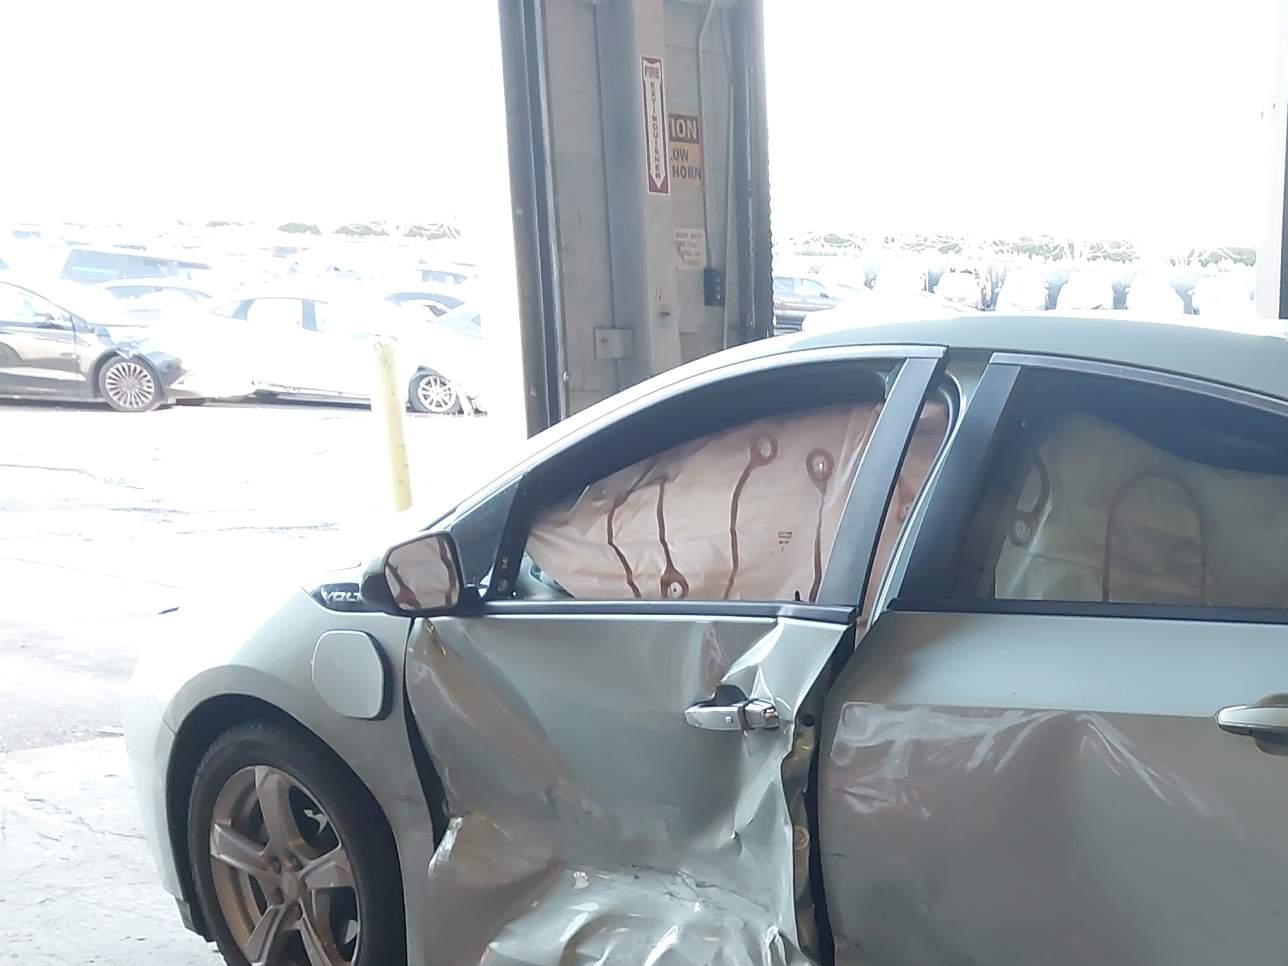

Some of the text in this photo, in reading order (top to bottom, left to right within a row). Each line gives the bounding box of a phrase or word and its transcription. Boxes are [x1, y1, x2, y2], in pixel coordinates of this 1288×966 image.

[645, 66, 660, 80] FIRE
[671, 117, 697, 140] ION
[670, 146, 689, 162] OW
[672, 164, 701, 180] HORN
[320, 586, 360, 604] VOLT
